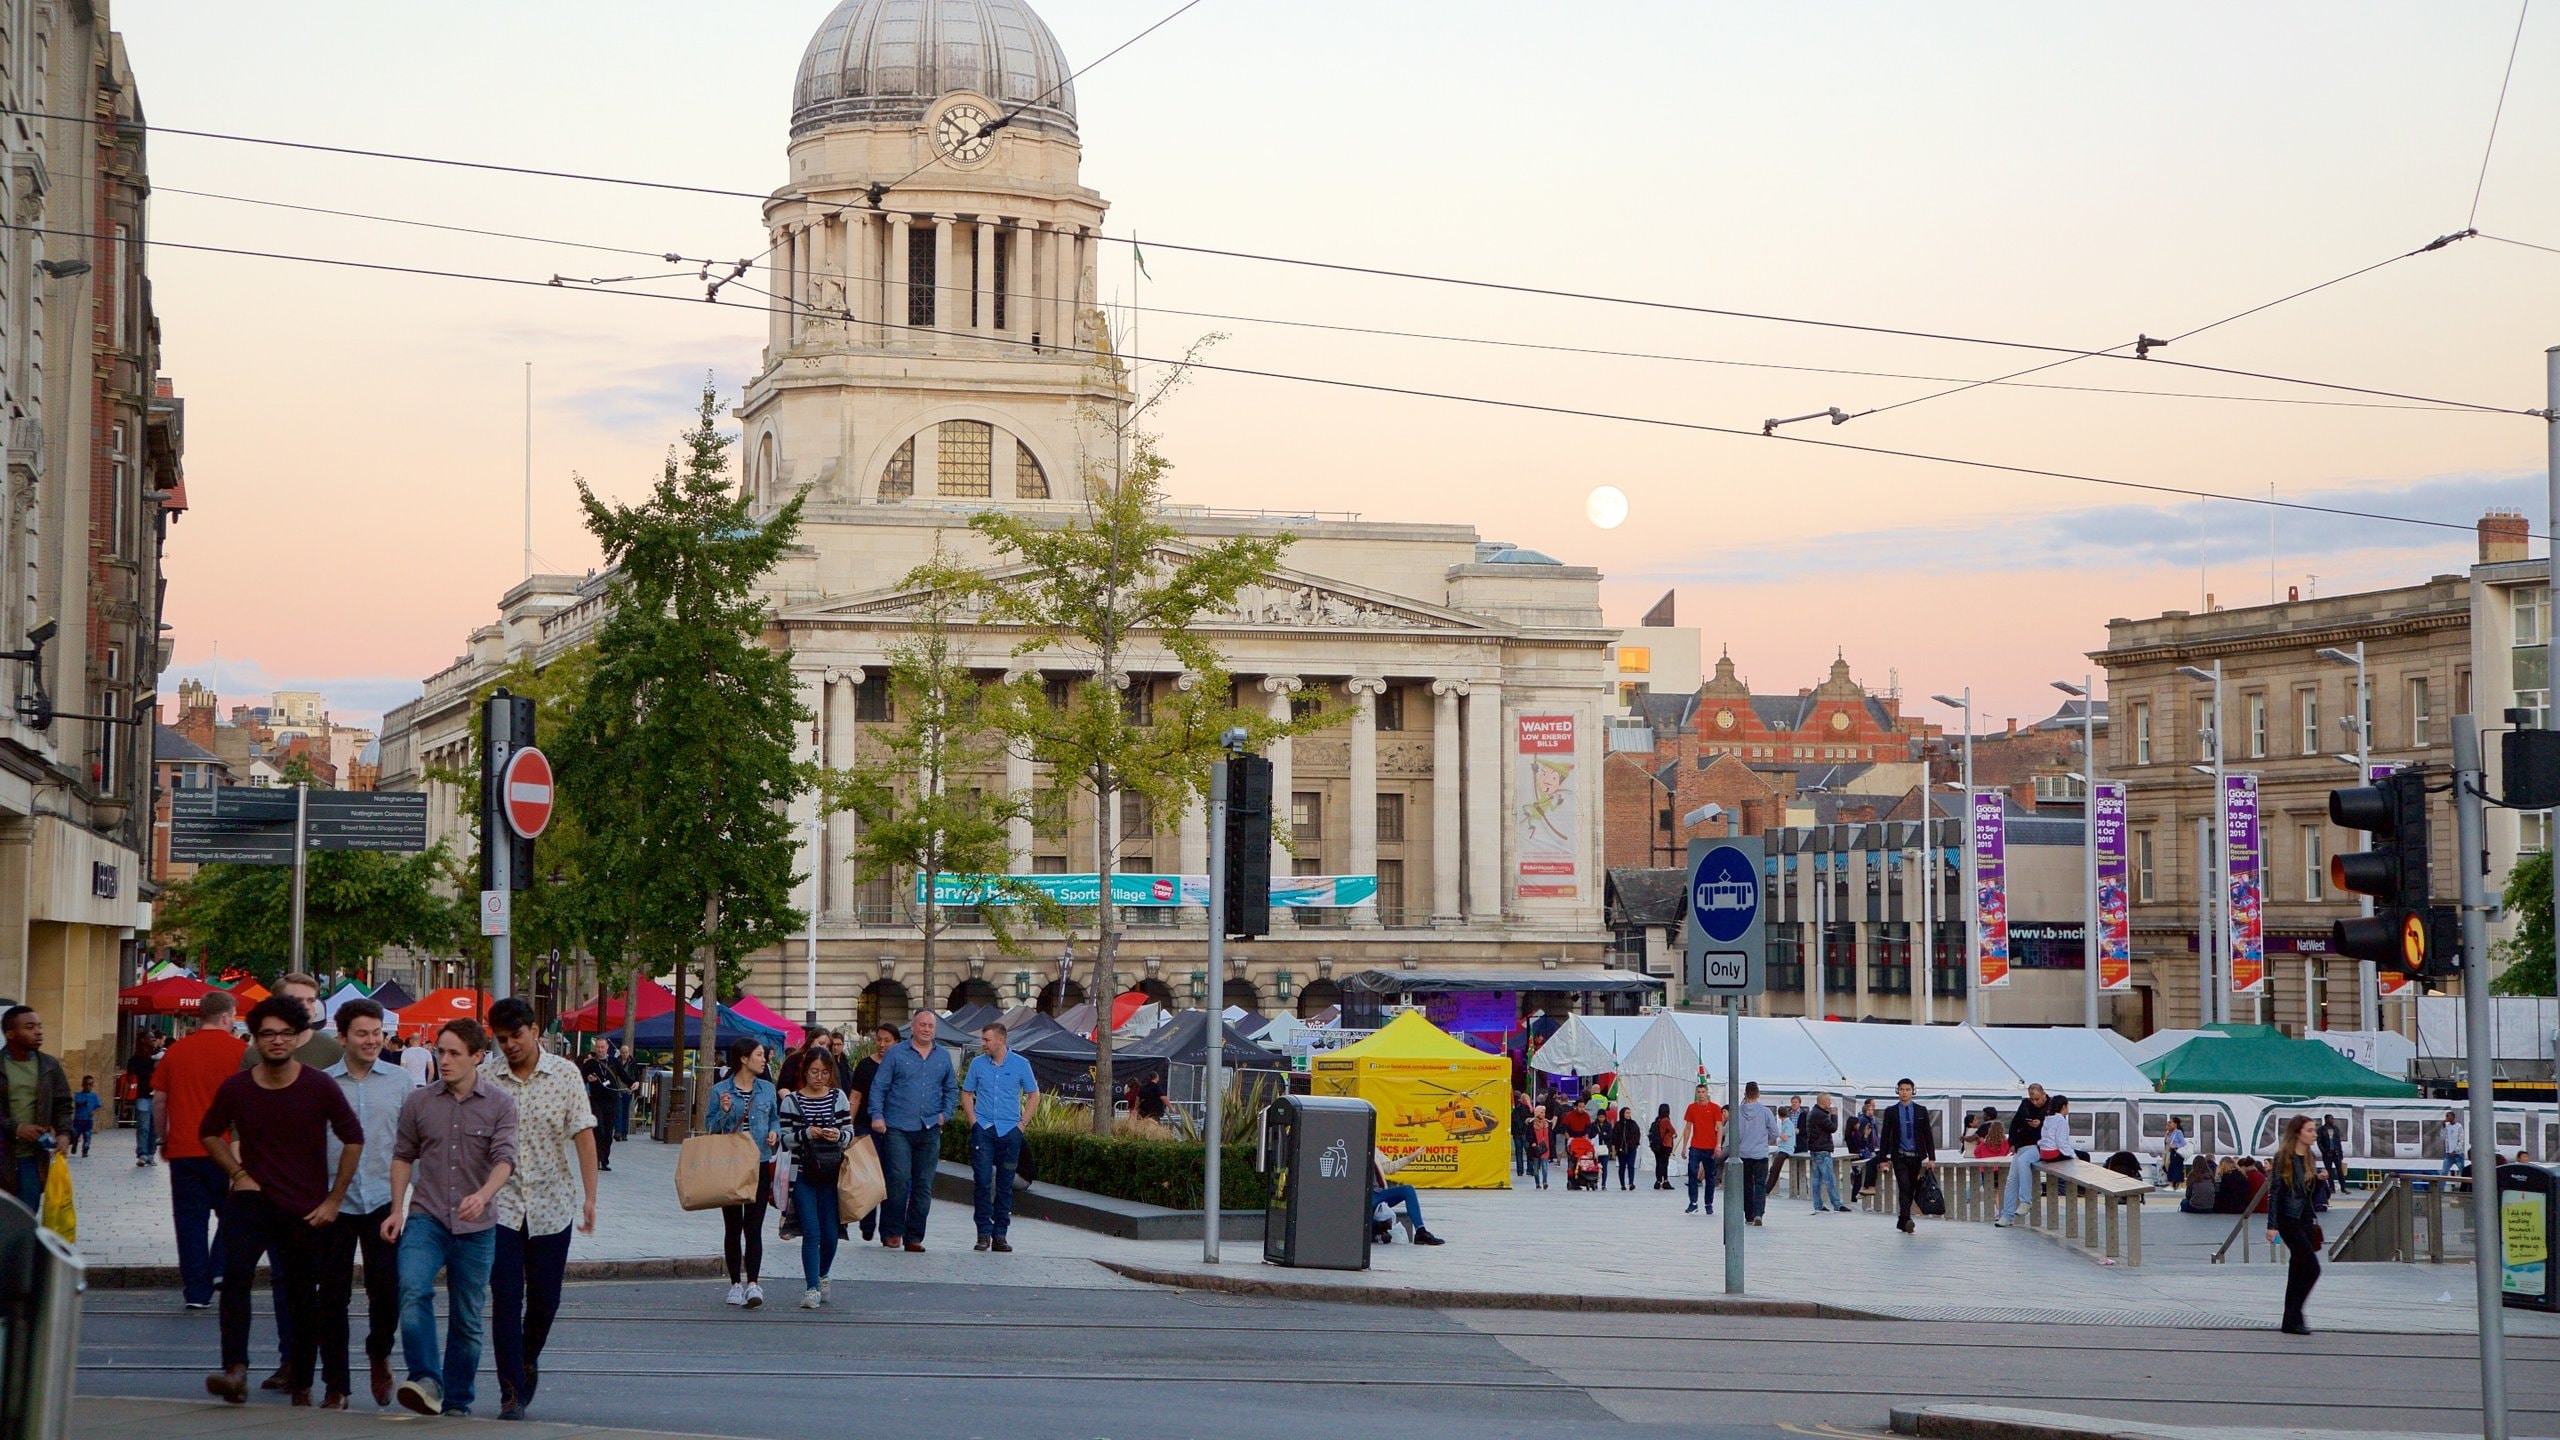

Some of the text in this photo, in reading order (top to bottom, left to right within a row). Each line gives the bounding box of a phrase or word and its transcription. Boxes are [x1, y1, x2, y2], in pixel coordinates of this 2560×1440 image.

[1521, 721, 1573, 732] WANTED
[1521, 733, 1572, 741] LOW ENERGY
[1536, 740, 1559, 748] BILLS
[2228, 789, 2256, 798] Goose
[2096, 797, 2124, 807] Goose
[2228, 798, 2245, 807] Fair
[1976, 804, 2002, 813] Goose
[2097, 806, 2113, 815] Fair
[351, 810, 424, 819] Nottingham Contemporary
[1976, 812, 1991, 820] Fair
[2228, 812, 2238, 820] 30
[2238, 812, 2253, 821] Sep
[2106, 819, 2120, 828] Sep
[2229, 821, 2248, 829] 4 Oct
[377, 825, 403, 833] Shopping
[1985, 825, 1998, 833] Sep
[381, 840, 402, 848] Railway
[1060, 888, 1100, 902] Sports
[1111, 888, 1147, 902] illage
[2296, 939, 2326, 951] NatWest
[1711, 961, 1740, 979] Only
[180, 998, 201, 1007] FIVE
[1061, 1083, 1081, 1091] THE
[1425, 1146, 1459, 1154] NOTTS
